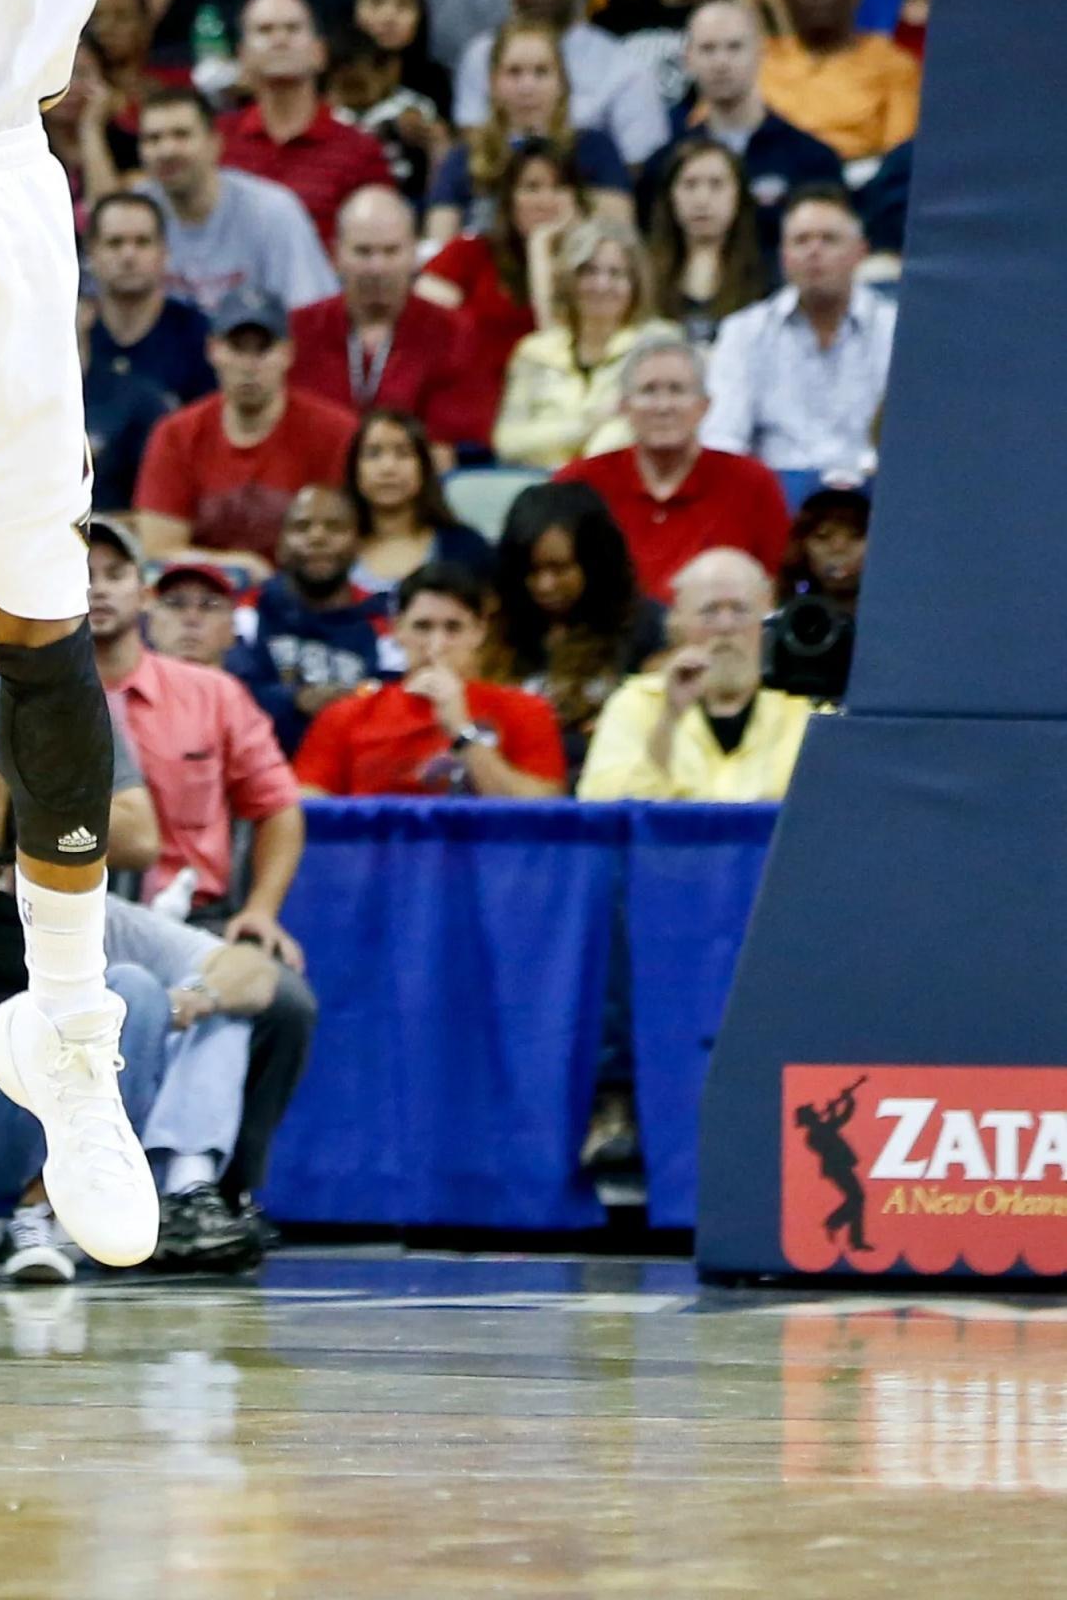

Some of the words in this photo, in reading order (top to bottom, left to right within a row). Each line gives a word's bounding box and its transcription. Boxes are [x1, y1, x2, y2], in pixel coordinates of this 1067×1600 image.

[868, 1098, 1067, 1182] ZATA
[881, 1184, 907, 1215] A
[909, 1184, 973, 1216] New
